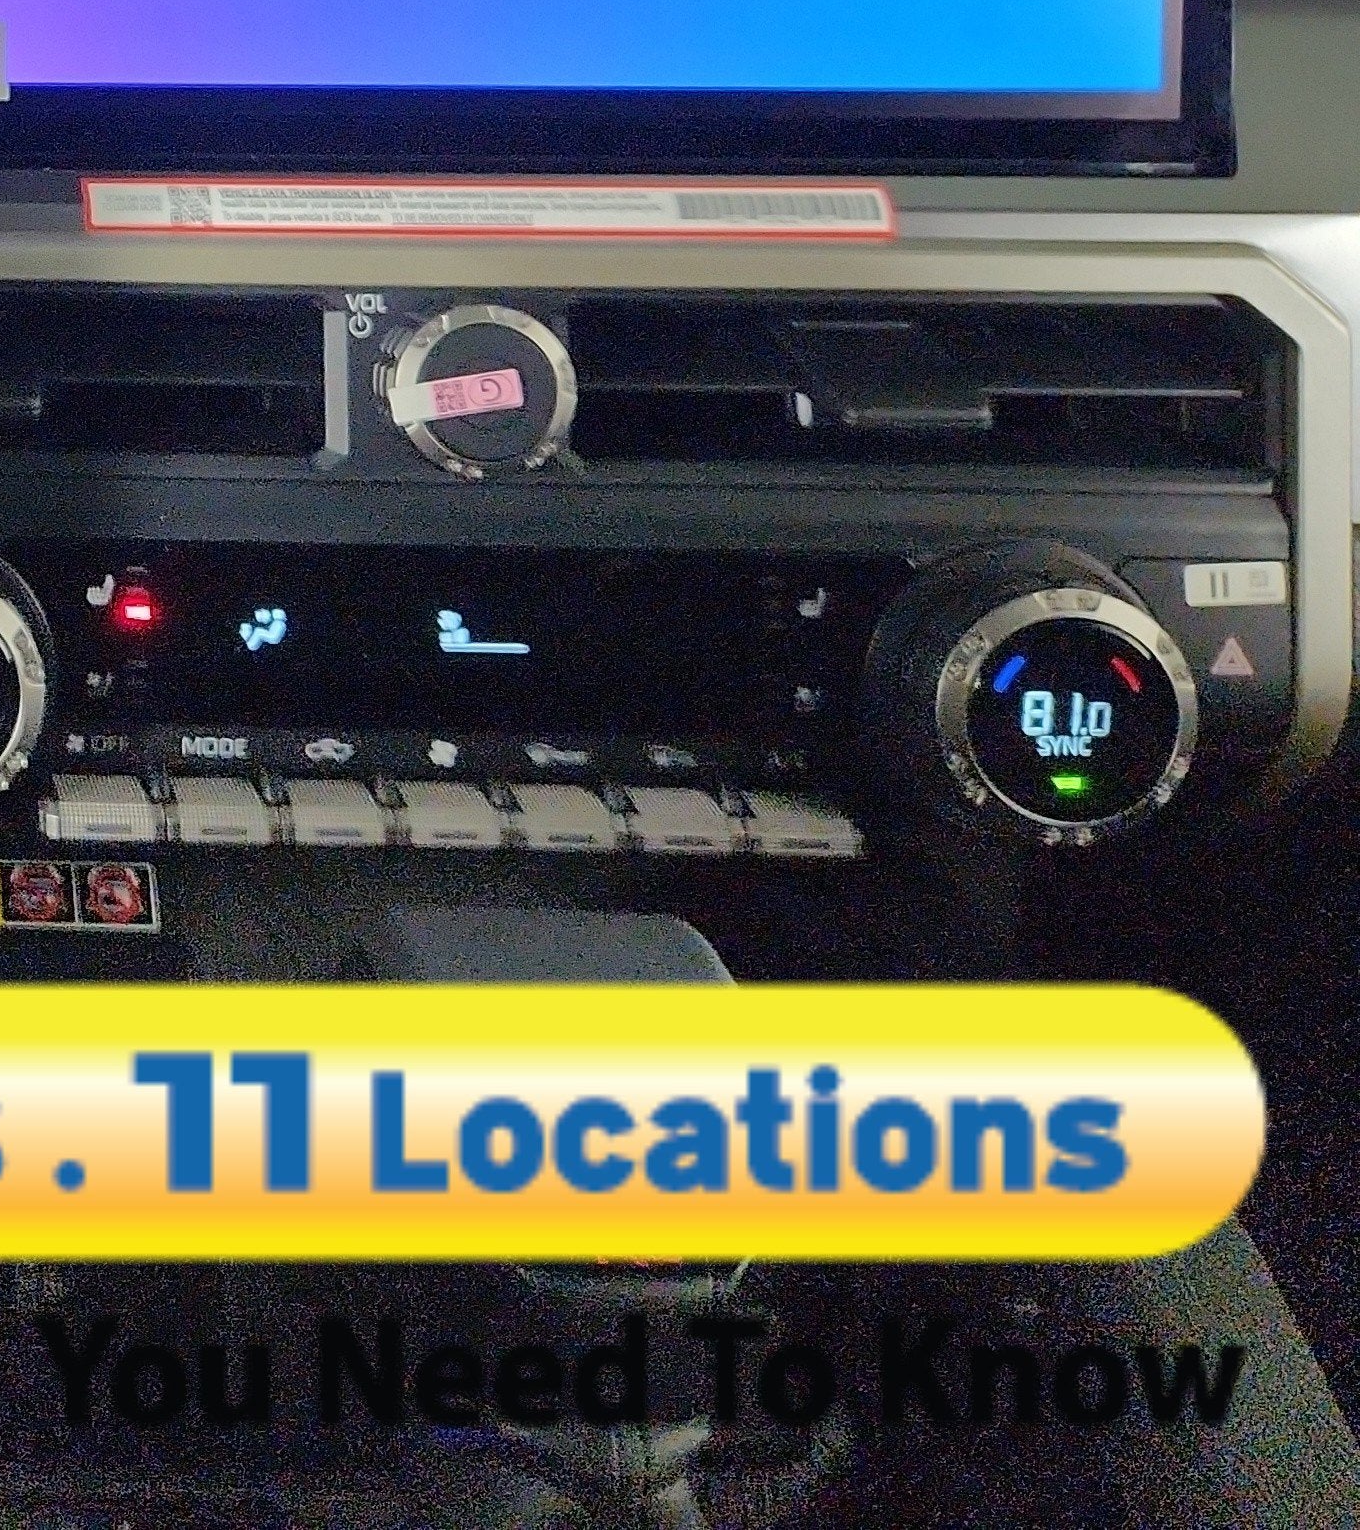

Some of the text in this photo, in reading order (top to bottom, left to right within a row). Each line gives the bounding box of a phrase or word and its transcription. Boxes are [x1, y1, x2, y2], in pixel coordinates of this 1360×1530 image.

[344, 293, 387, 314] VOL
[1021, 690, 1112, 738] 81.0
[181, 735, 249, 757] MODE
[1036, 736, 1094, 758] SYNC
